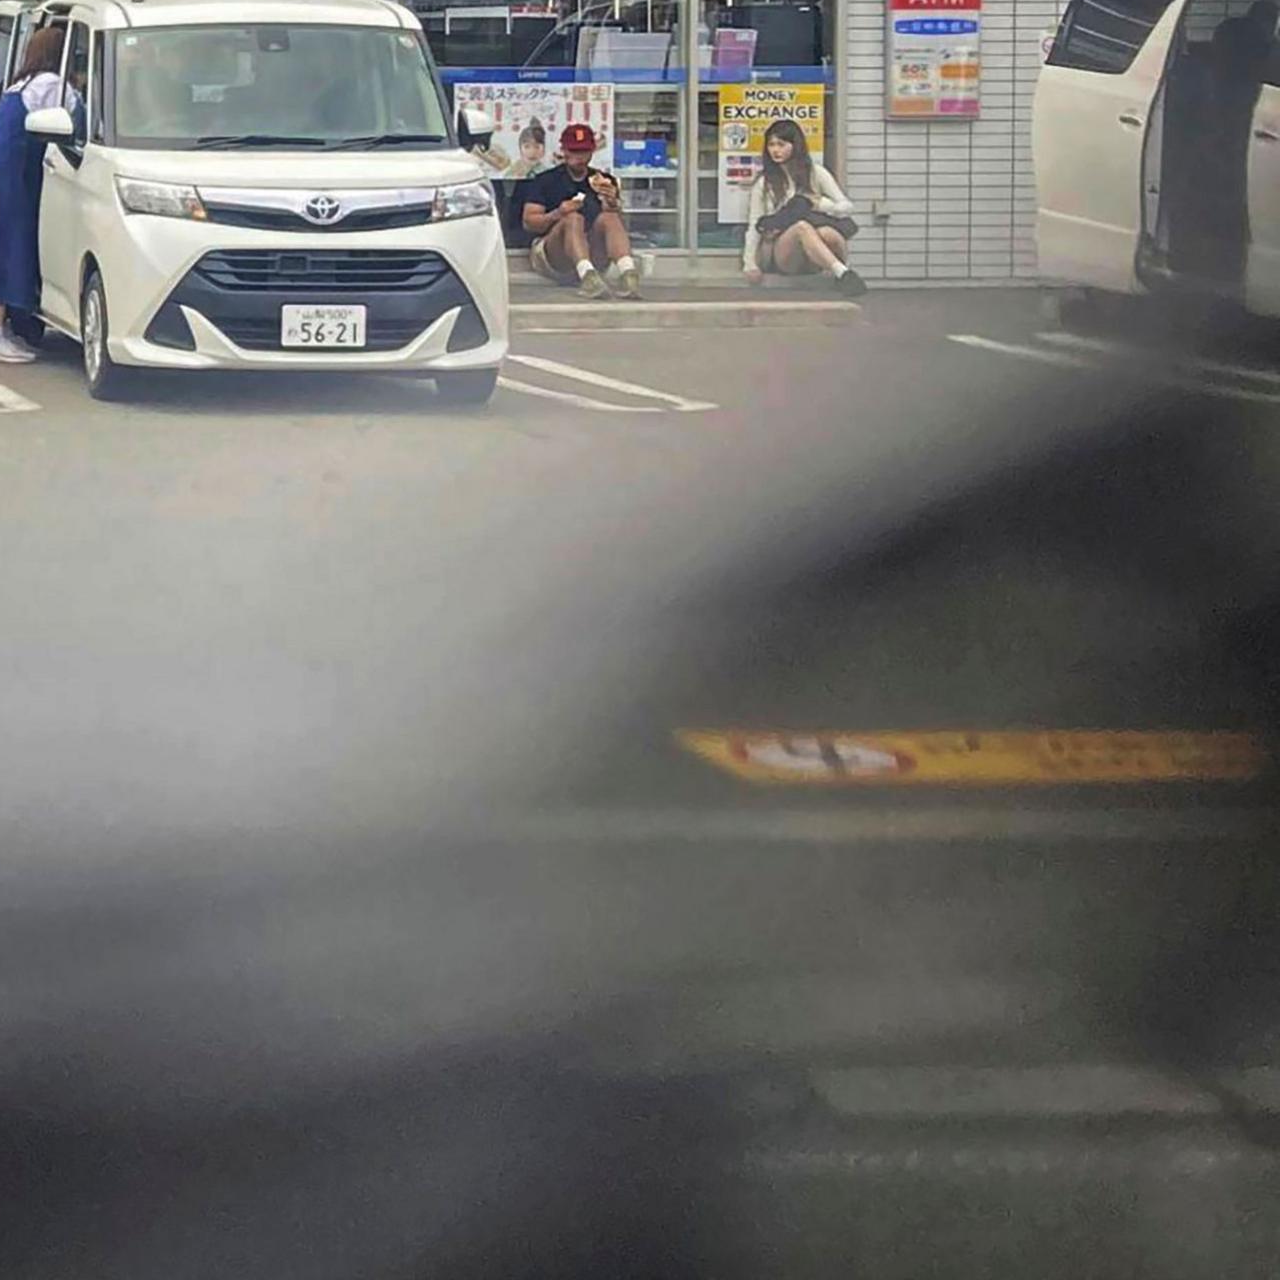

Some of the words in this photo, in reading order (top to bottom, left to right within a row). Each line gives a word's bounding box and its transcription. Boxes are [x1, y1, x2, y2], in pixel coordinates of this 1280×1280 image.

[745, 90, 796, 101] MONEY
[723, 106, 819, 119] EXCHANGE
[301, 323, 358, 343] 56-21
